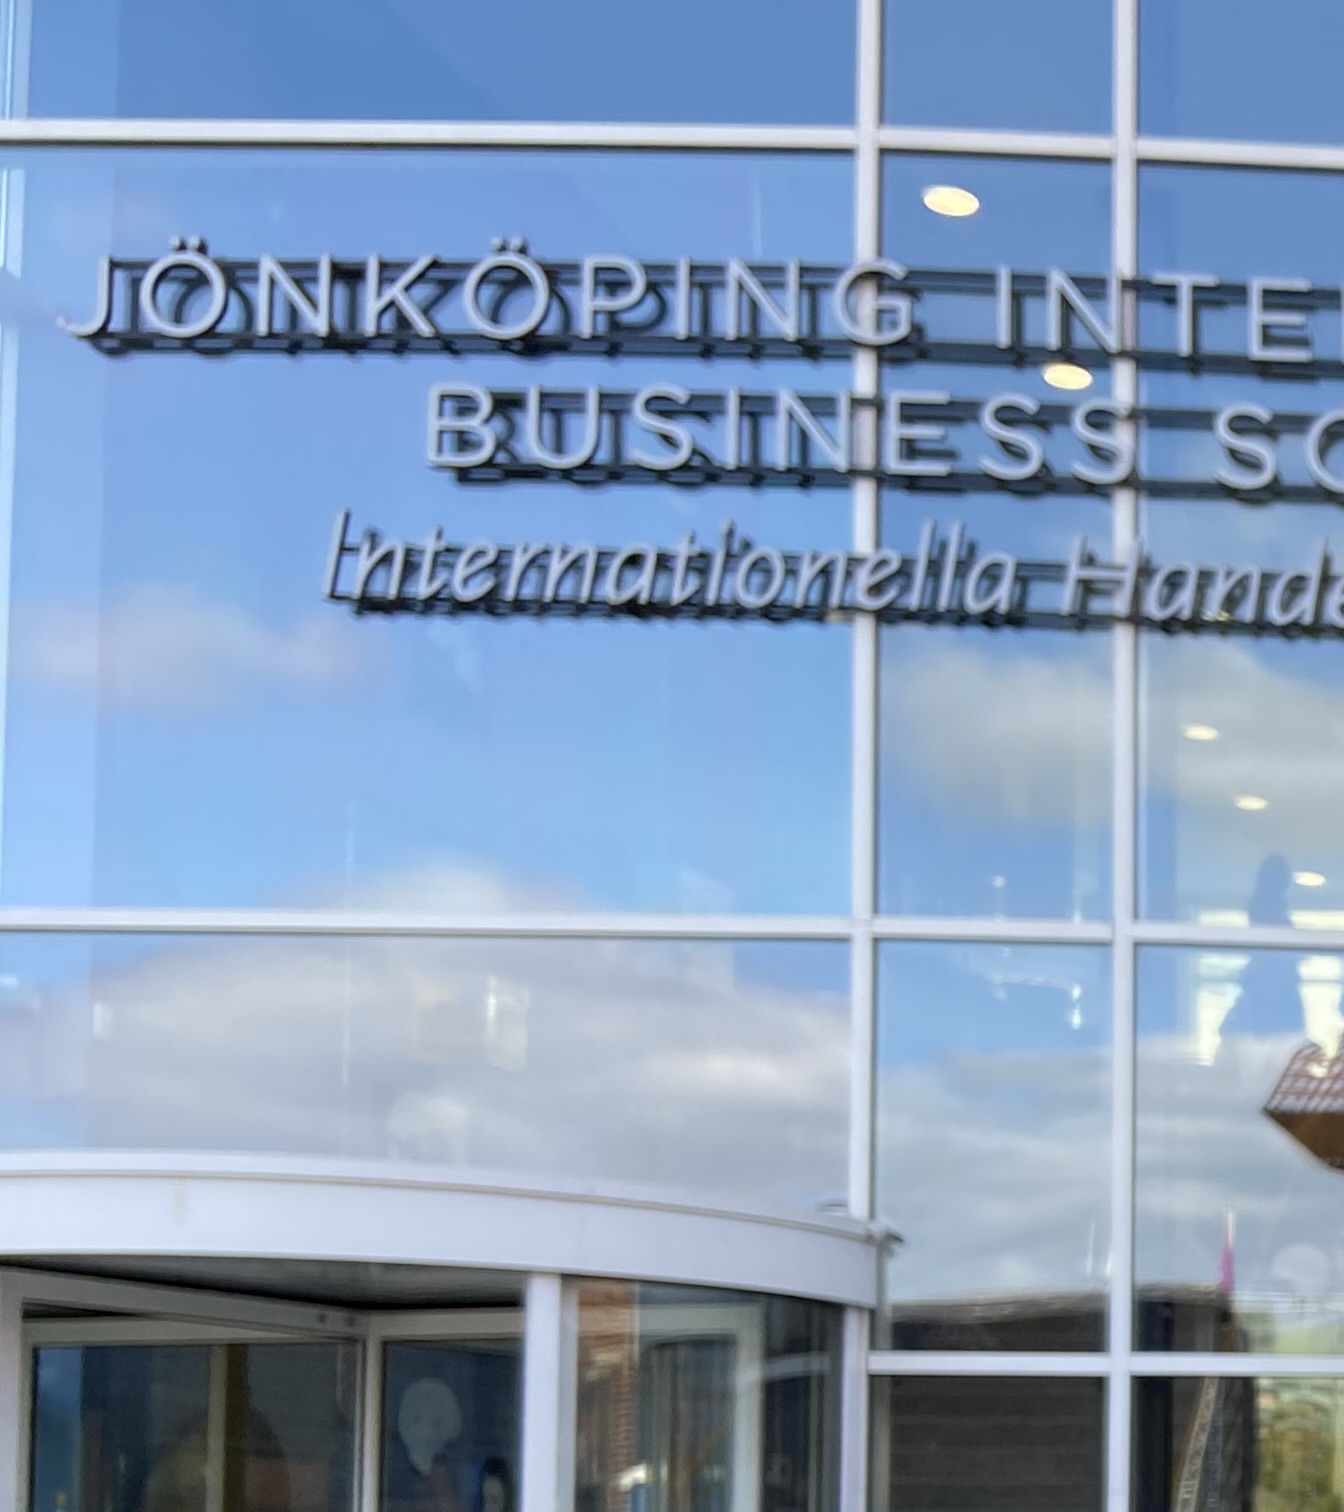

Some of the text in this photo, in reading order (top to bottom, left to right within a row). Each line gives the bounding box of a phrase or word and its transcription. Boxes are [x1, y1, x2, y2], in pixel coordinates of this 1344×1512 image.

[57, 236, 914, 346] JÖNKÖPING
[426, 382, 1136, 486] BUSINESS
[322, 506, 1012, 615] Internationella
